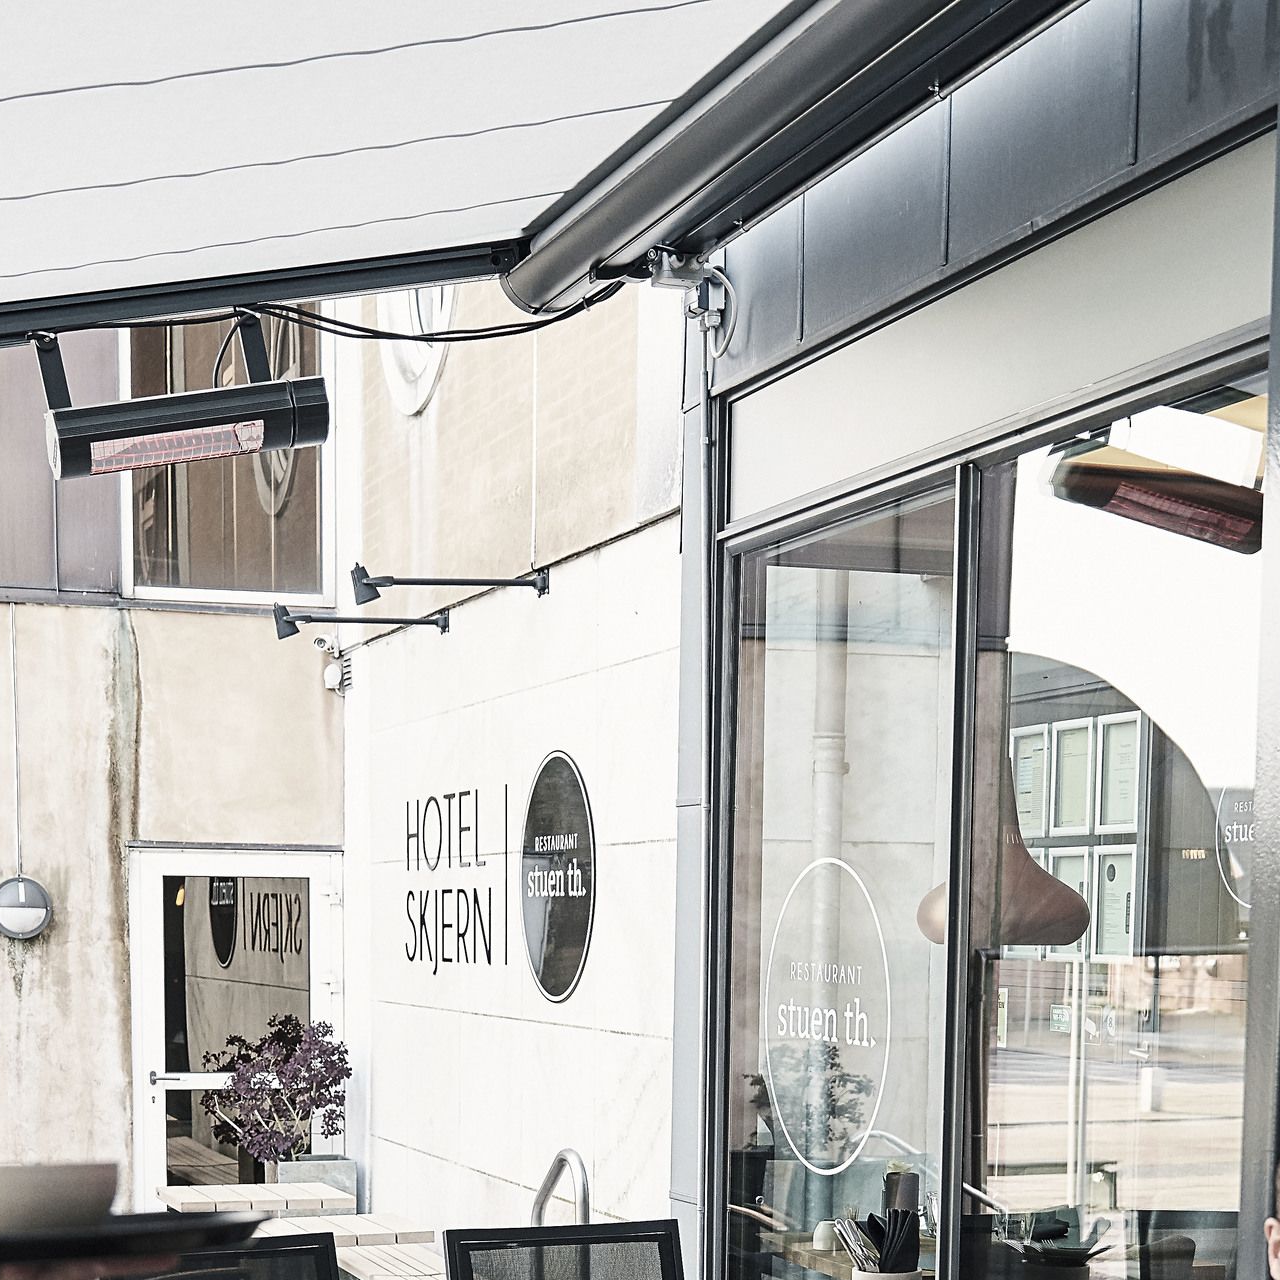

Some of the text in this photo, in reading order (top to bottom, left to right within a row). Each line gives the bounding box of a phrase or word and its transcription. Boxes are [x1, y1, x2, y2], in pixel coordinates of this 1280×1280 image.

[1233, 800, 1255, 813] REST
[406, 788, 486, 871] HOTEL
[534, 832, 578, 852] RESTAURANT
[1224, 820, 1255, 843] stue
[527, 864, 565, 898] stuen
[405, 887, 492, 975] SKJERN
[790, 961, 863, 985] RESTAURANT
[777, 997, 839, 1043] stuen
